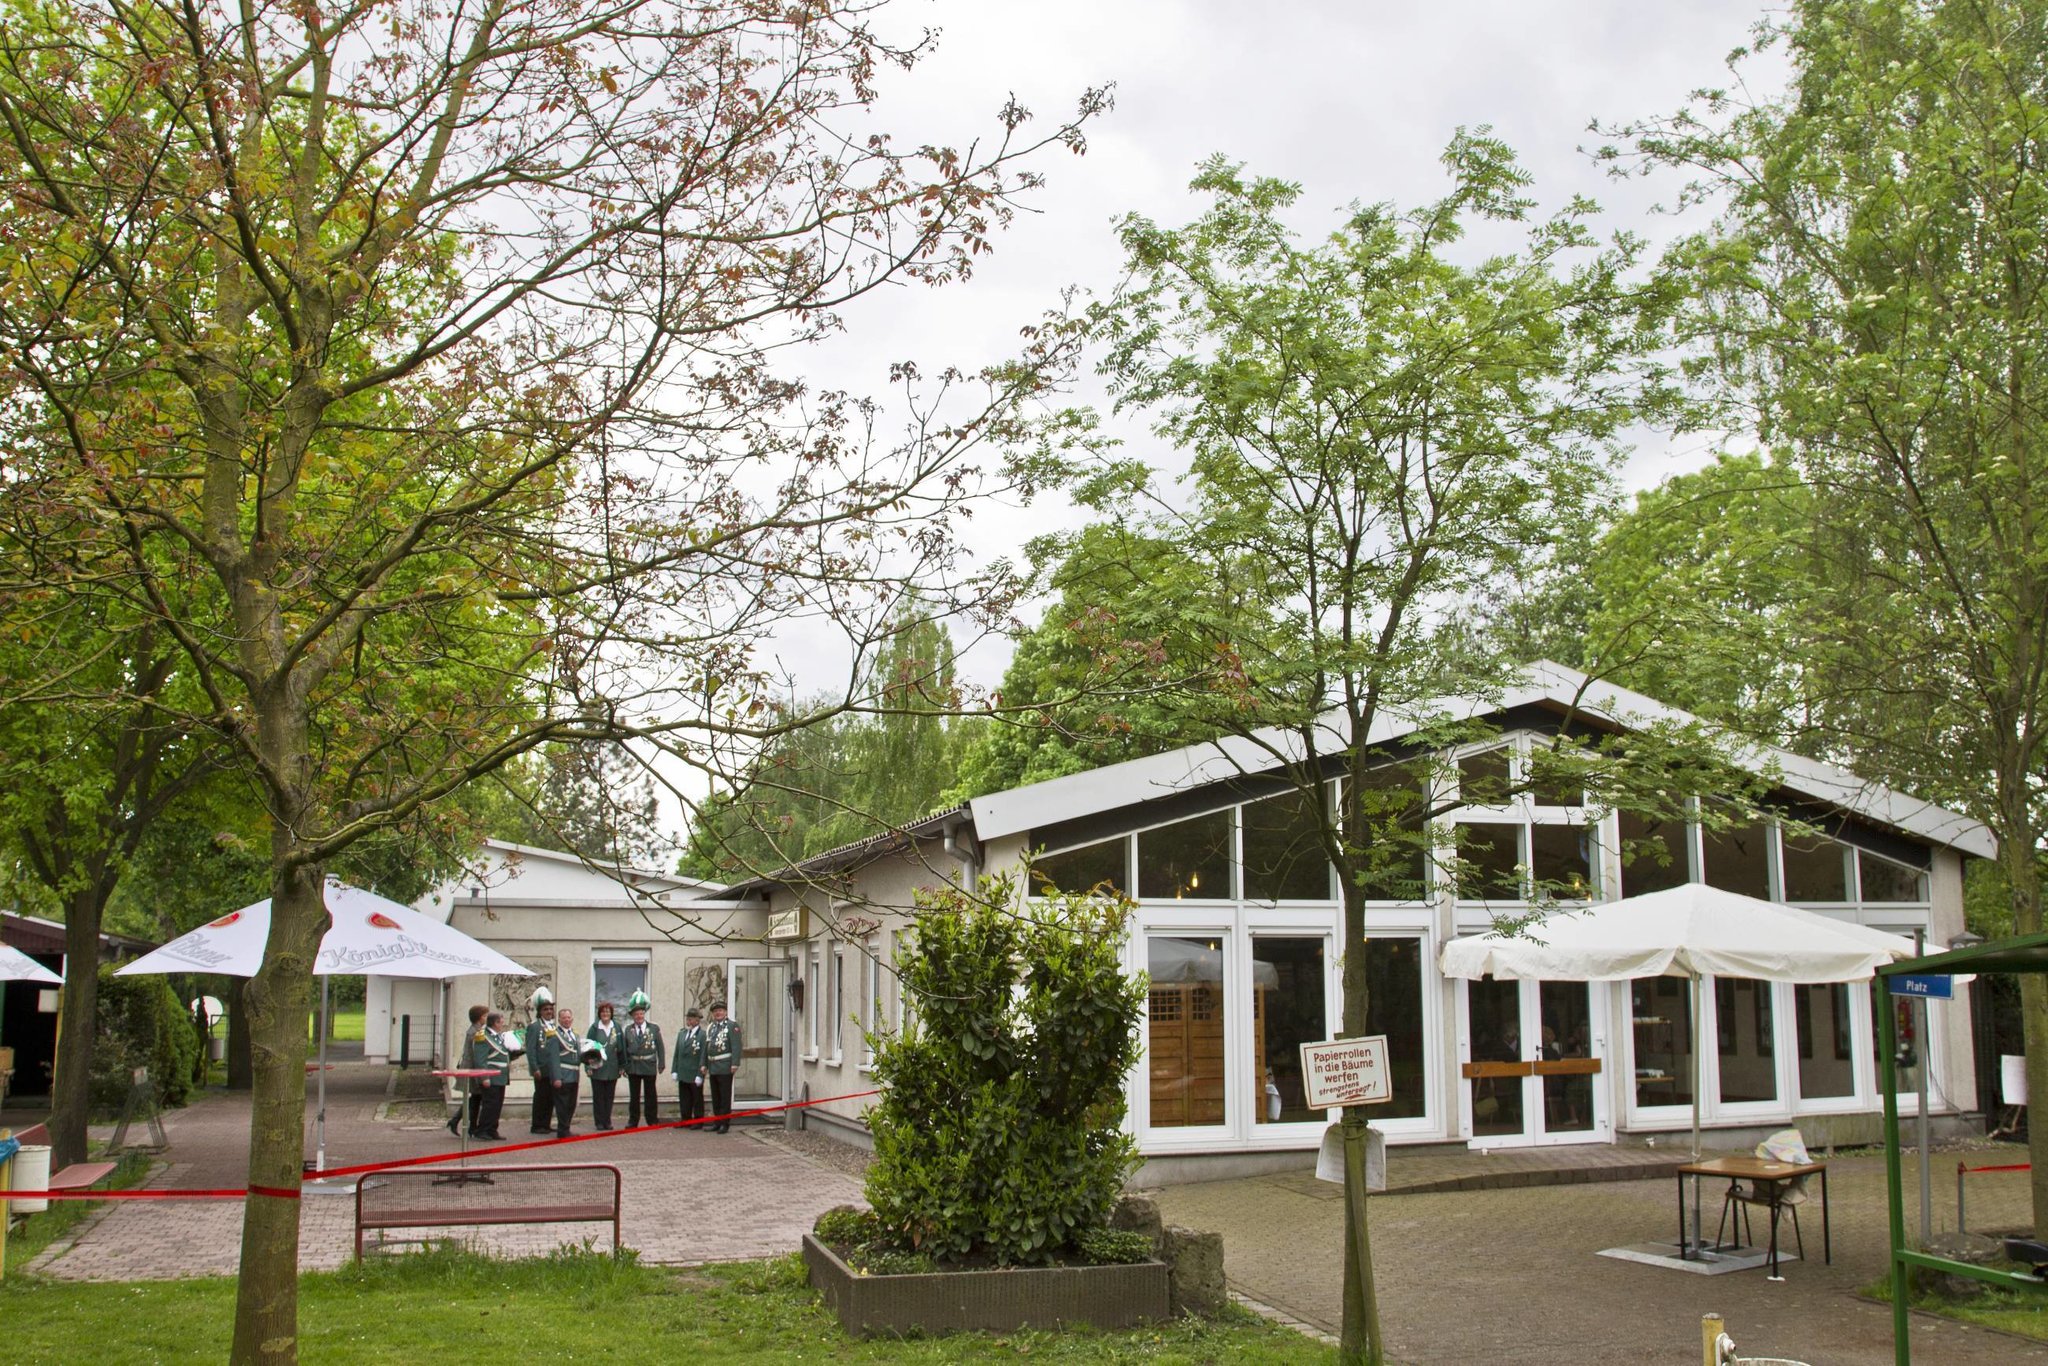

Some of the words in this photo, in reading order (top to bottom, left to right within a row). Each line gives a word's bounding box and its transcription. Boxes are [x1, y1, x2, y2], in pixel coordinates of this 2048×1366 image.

[320, 943, 404, 969] König
[1905, 979, 1929, 993] Platz
[1313, 1048, 1372, 1063] Papierrollen
[1314, 1063, 1323, 1074] in
[1324, 1061, 1340, 1072] die
[1341, 1059, 1374, 1071] Bäume
[1324, 1071, 1359, 1083] werfen
[1318, 1081, 1360, 1096] strengstens
